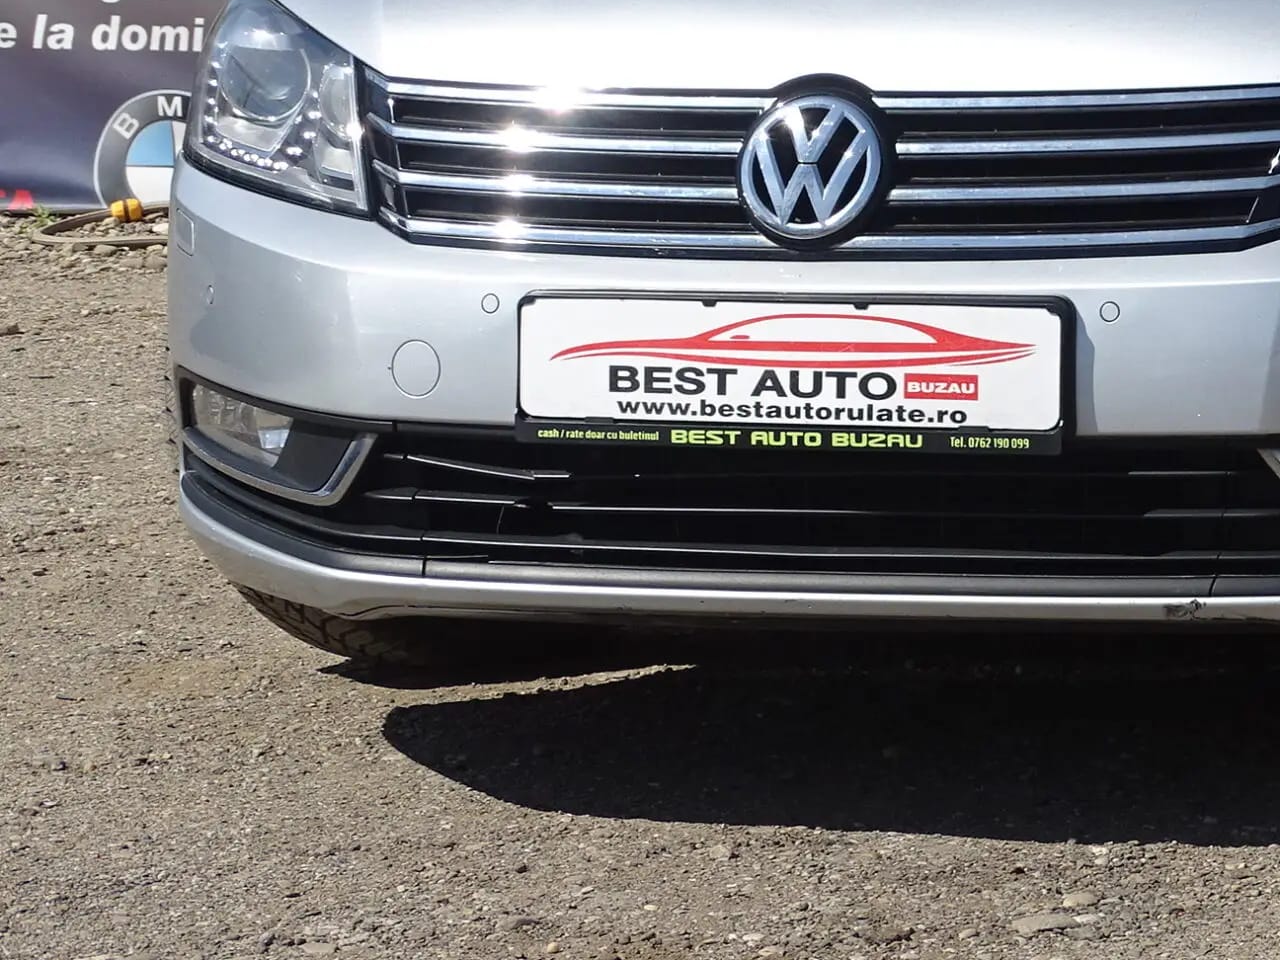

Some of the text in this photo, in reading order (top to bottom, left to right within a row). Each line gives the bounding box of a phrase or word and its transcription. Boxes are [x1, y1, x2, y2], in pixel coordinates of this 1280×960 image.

[32, 14, 75, 51] la
[608, 365, 976, 400] BEST AUTO BUZAU
[617, 399, 968, 425] www.bestautorulate.ro
[537, 428, 560, 438] cash
[565, 429, 584, 439] rate
[585, 429, 605, 439] doar
[606, 430, 618, 440] cu
[618, 430, 660, 441] buletinul
[670, 429, 923, 449] BEST AUTO BUZAU
[949, 436, 1030, 449] Tel. 0762 190 099
